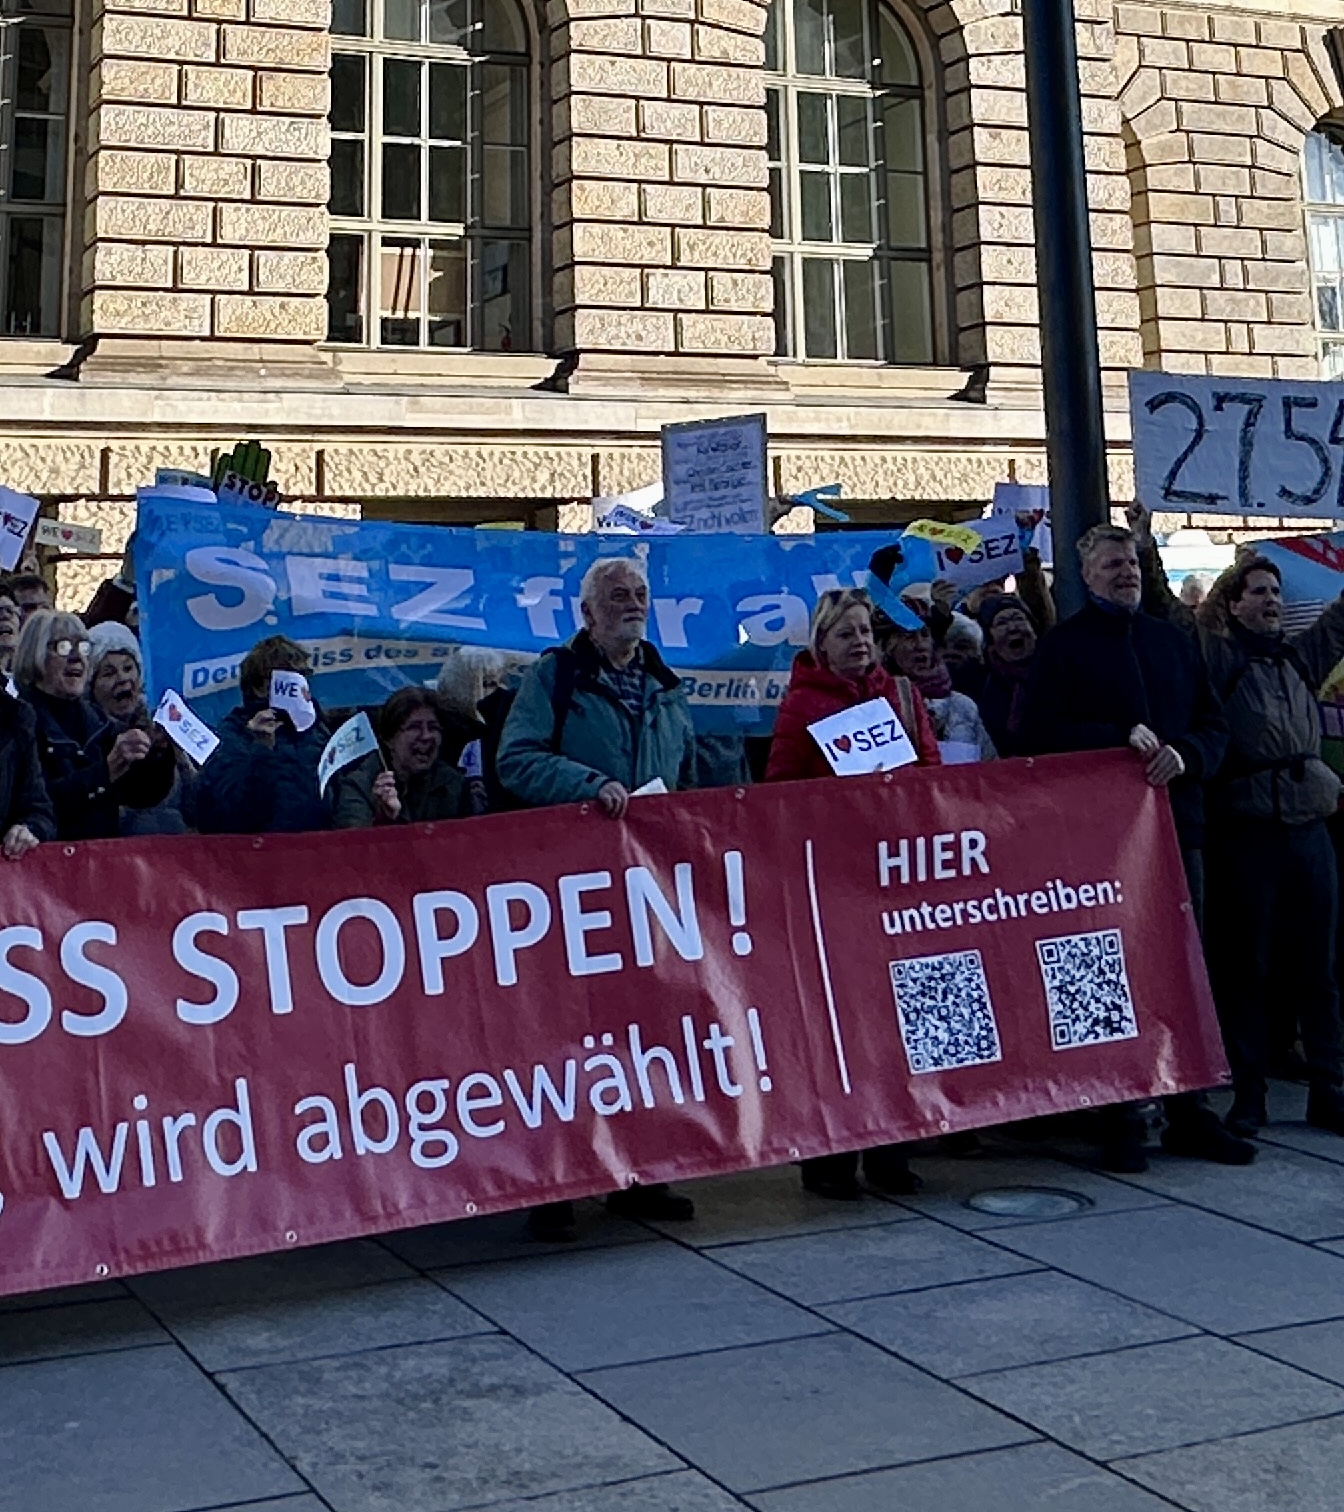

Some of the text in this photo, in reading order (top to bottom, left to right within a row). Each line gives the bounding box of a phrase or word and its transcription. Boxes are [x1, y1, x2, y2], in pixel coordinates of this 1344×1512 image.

[937, 550, 946, 572] I
[968, 533, 1018, 564] SEZ
[184, 546, 488, 632] SEZ
[513, 575, 704, 649] fr
[274, 680, 299, 698] WE
[680, 676, 756, 700] Berlin
[825, 719, 904, 762] I SEZ
[877, 829, 991, 887] HIER
[881, 877, 1124, 936] unterschreiben:
[171, 849, 753, 1026] STOPPEN!
[42, 1077, 258, 1201] wird
[292, 1006, 774, 1169] abgewählt!
